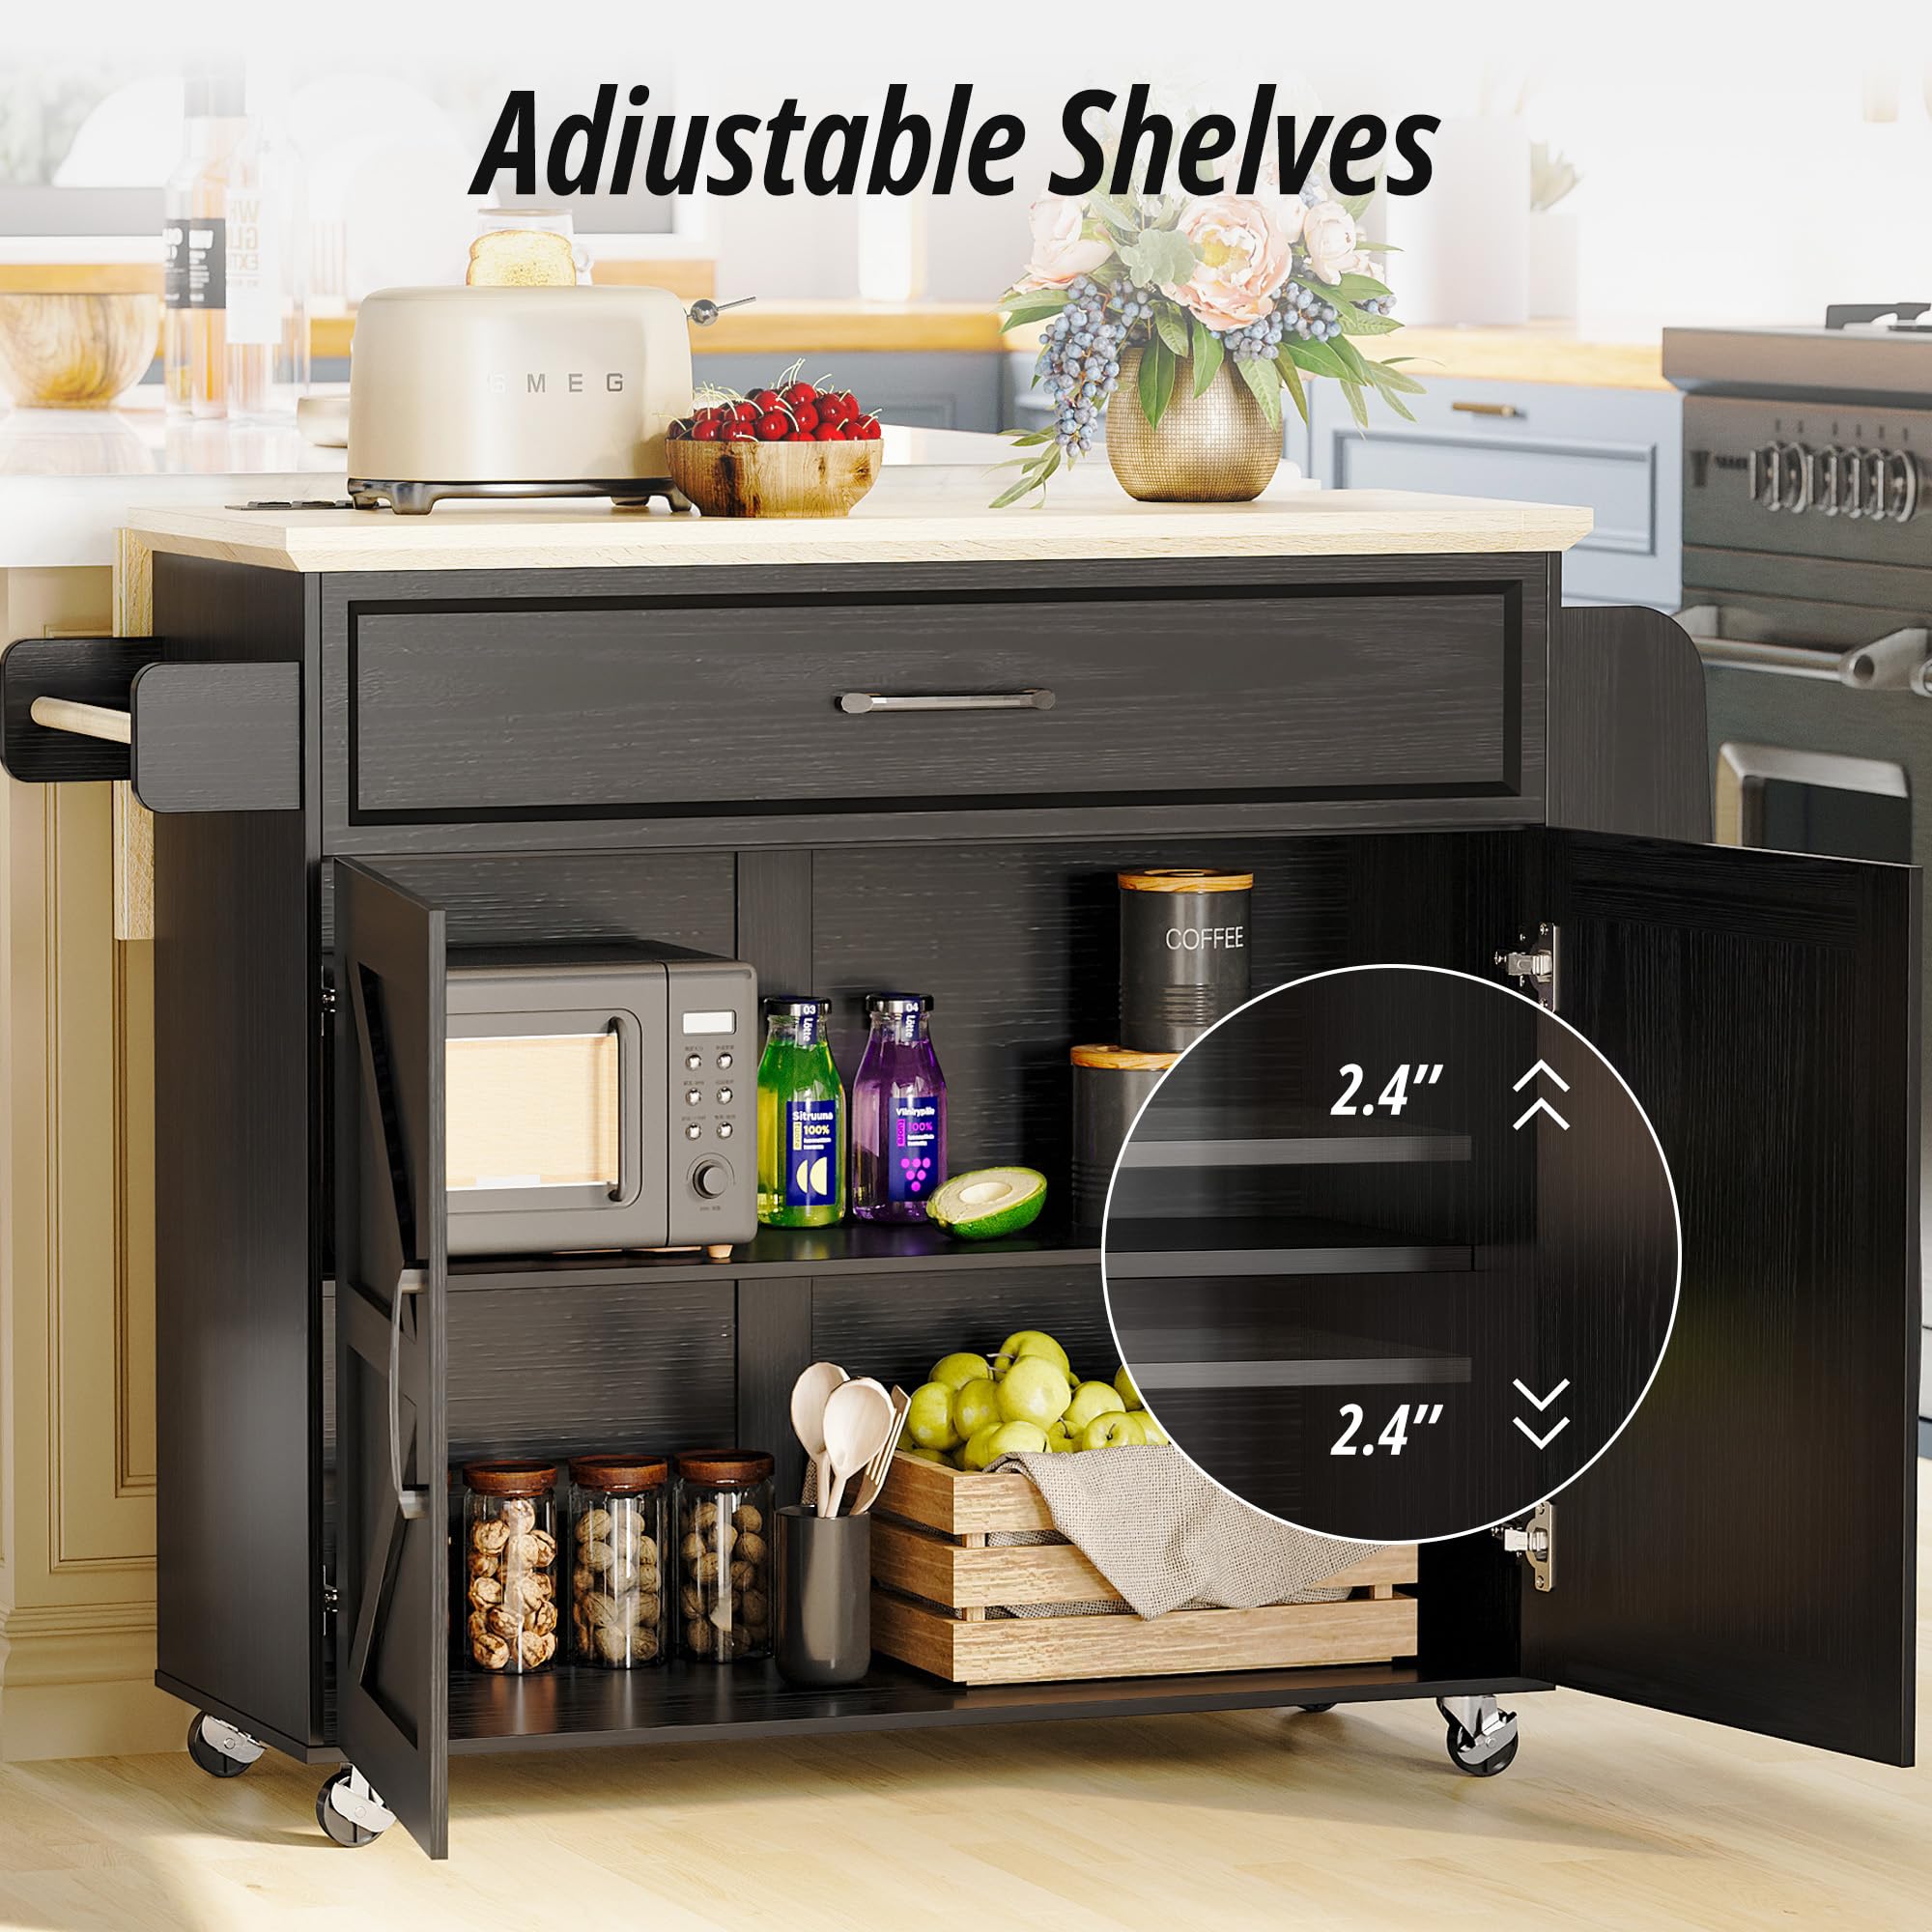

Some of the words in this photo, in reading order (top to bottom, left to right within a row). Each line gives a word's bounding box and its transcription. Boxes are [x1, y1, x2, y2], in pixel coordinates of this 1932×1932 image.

[1166, 926, 1243, 950] COFFEE
[803, 1005, 816, 1014] 03
[906, 1003, 919, 1012] 04
[803, 1124, 830, 1135] 100%
